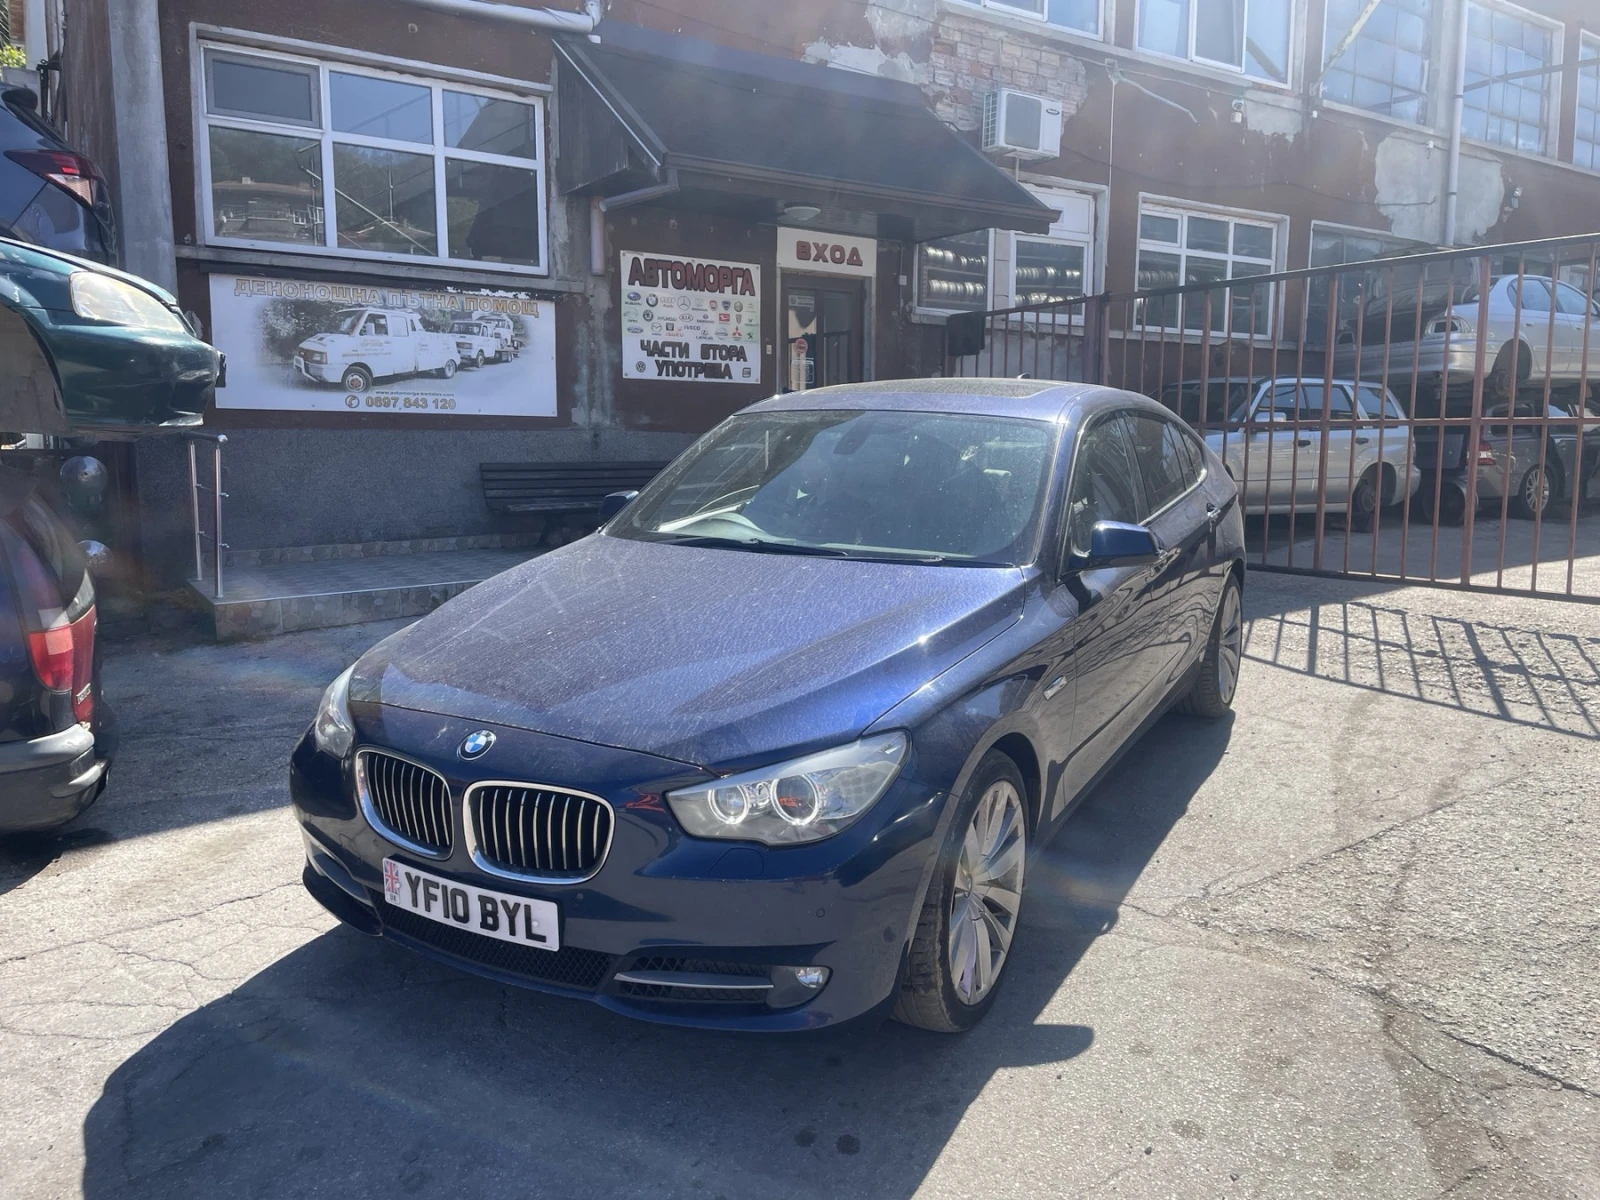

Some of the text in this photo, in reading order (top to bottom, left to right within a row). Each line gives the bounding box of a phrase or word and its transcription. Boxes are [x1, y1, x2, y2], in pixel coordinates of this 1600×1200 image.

[796, 240, 863, 267] ВХОД
[628, 256, 756, 297] АВТОМОРГА
[234, 278, 540, 319] ДЕНОНОЩНА ПЪТНА ПОМОЩ
[640, 339, 690, 359] ЧАСТИ
[365, 395, 457, 410] 0897 843 120
[405, 871, 547, 943] YF10 BYL
